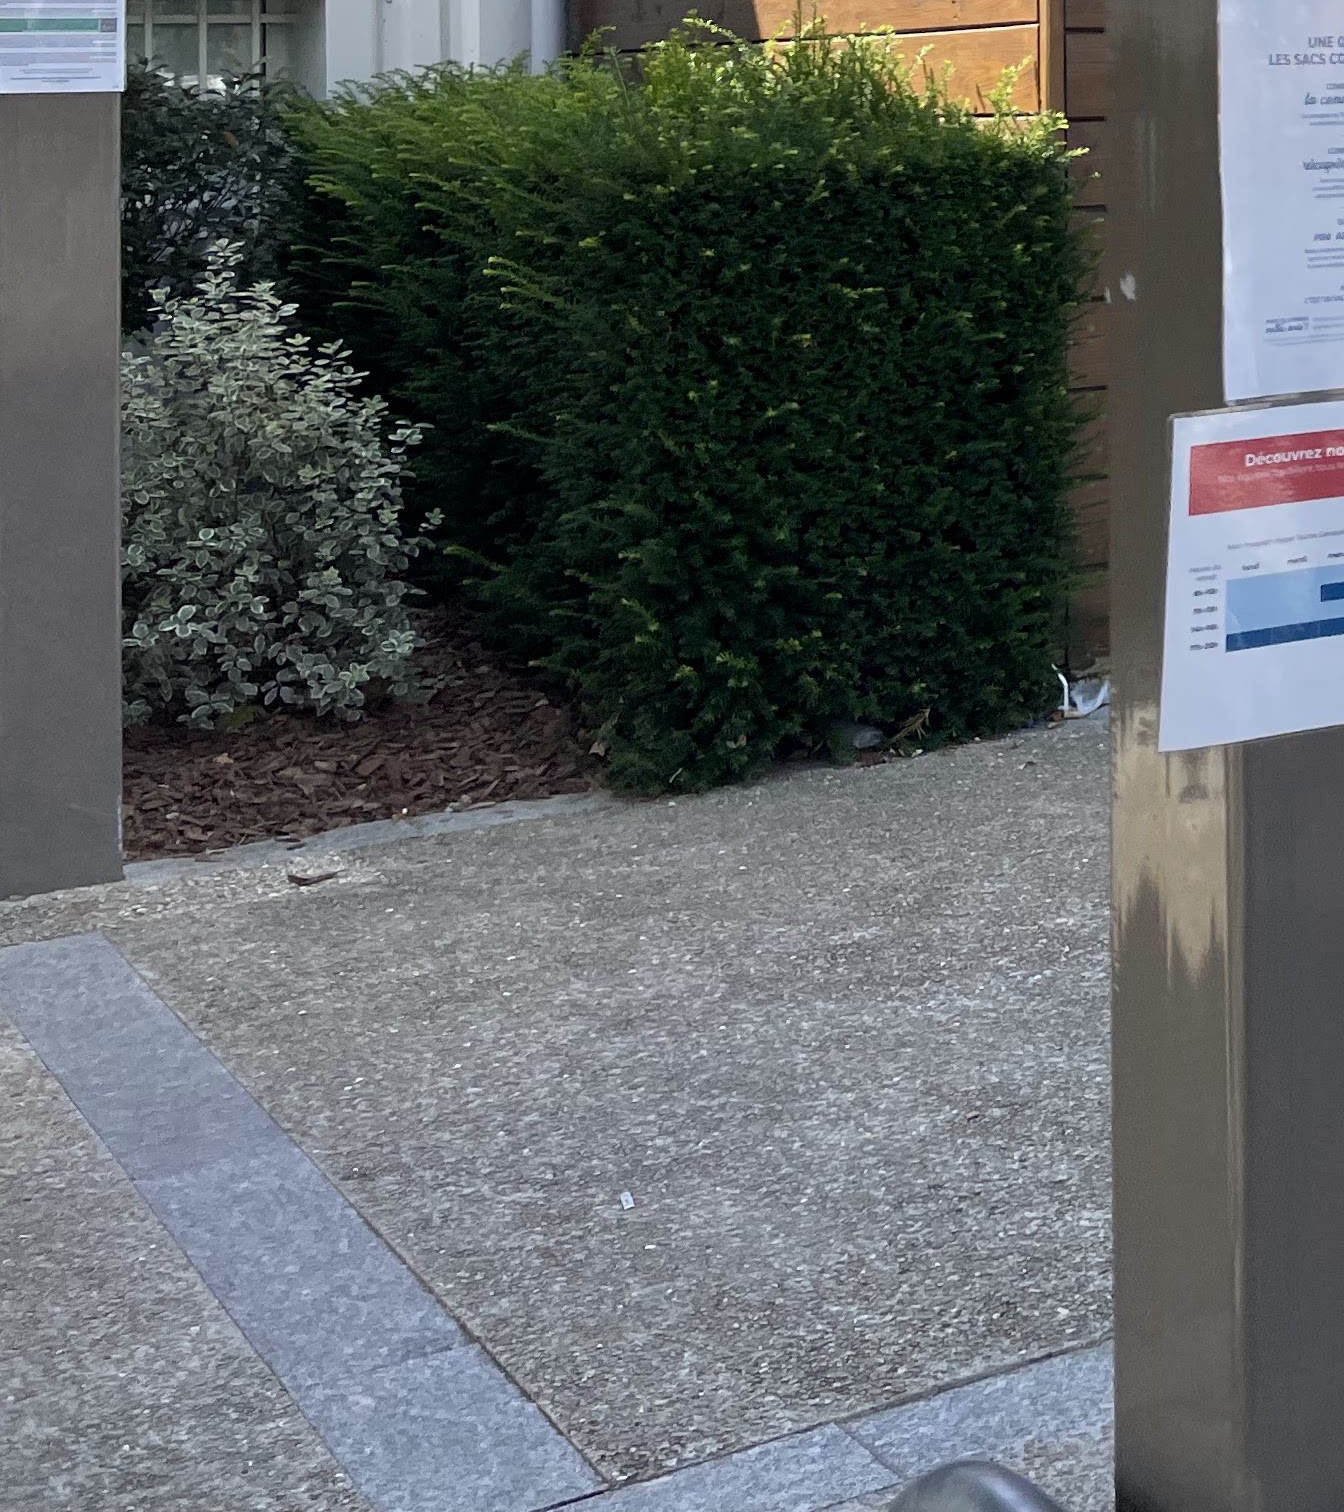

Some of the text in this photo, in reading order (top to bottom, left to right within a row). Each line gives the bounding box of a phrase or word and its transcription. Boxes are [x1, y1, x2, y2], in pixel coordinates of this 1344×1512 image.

[1308, 36, 1334, 48] UNE
[1268, 53, 1291, 65] LES
[1294, 53, 1326, 65] SACS
[1244, 451, 1323, 467] Découvrez
